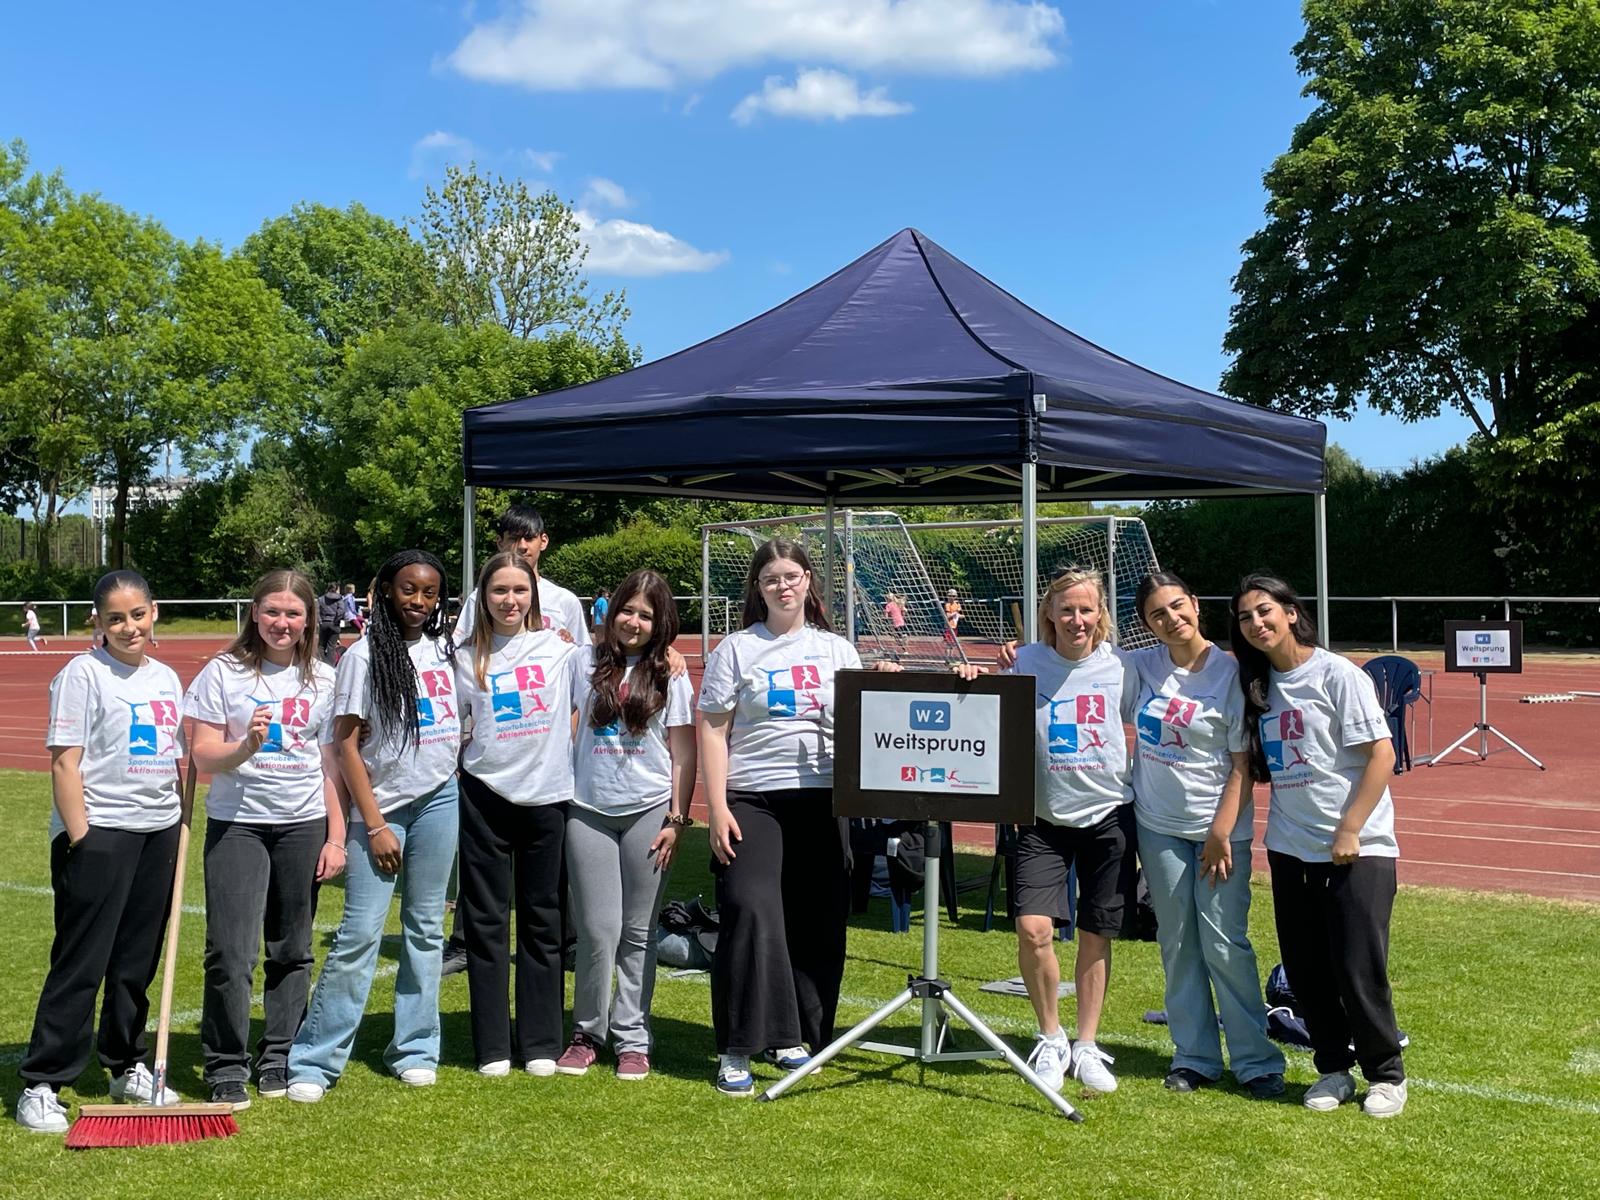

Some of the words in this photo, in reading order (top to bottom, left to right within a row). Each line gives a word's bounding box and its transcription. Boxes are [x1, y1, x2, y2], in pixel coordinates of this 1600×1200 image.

[1461, 645, 1505, 653] Weitsprung
[915, 709, 930, 723] W
[934, 710, 945, 723] 2
[874, 732, 986, 757] Weitsprung
